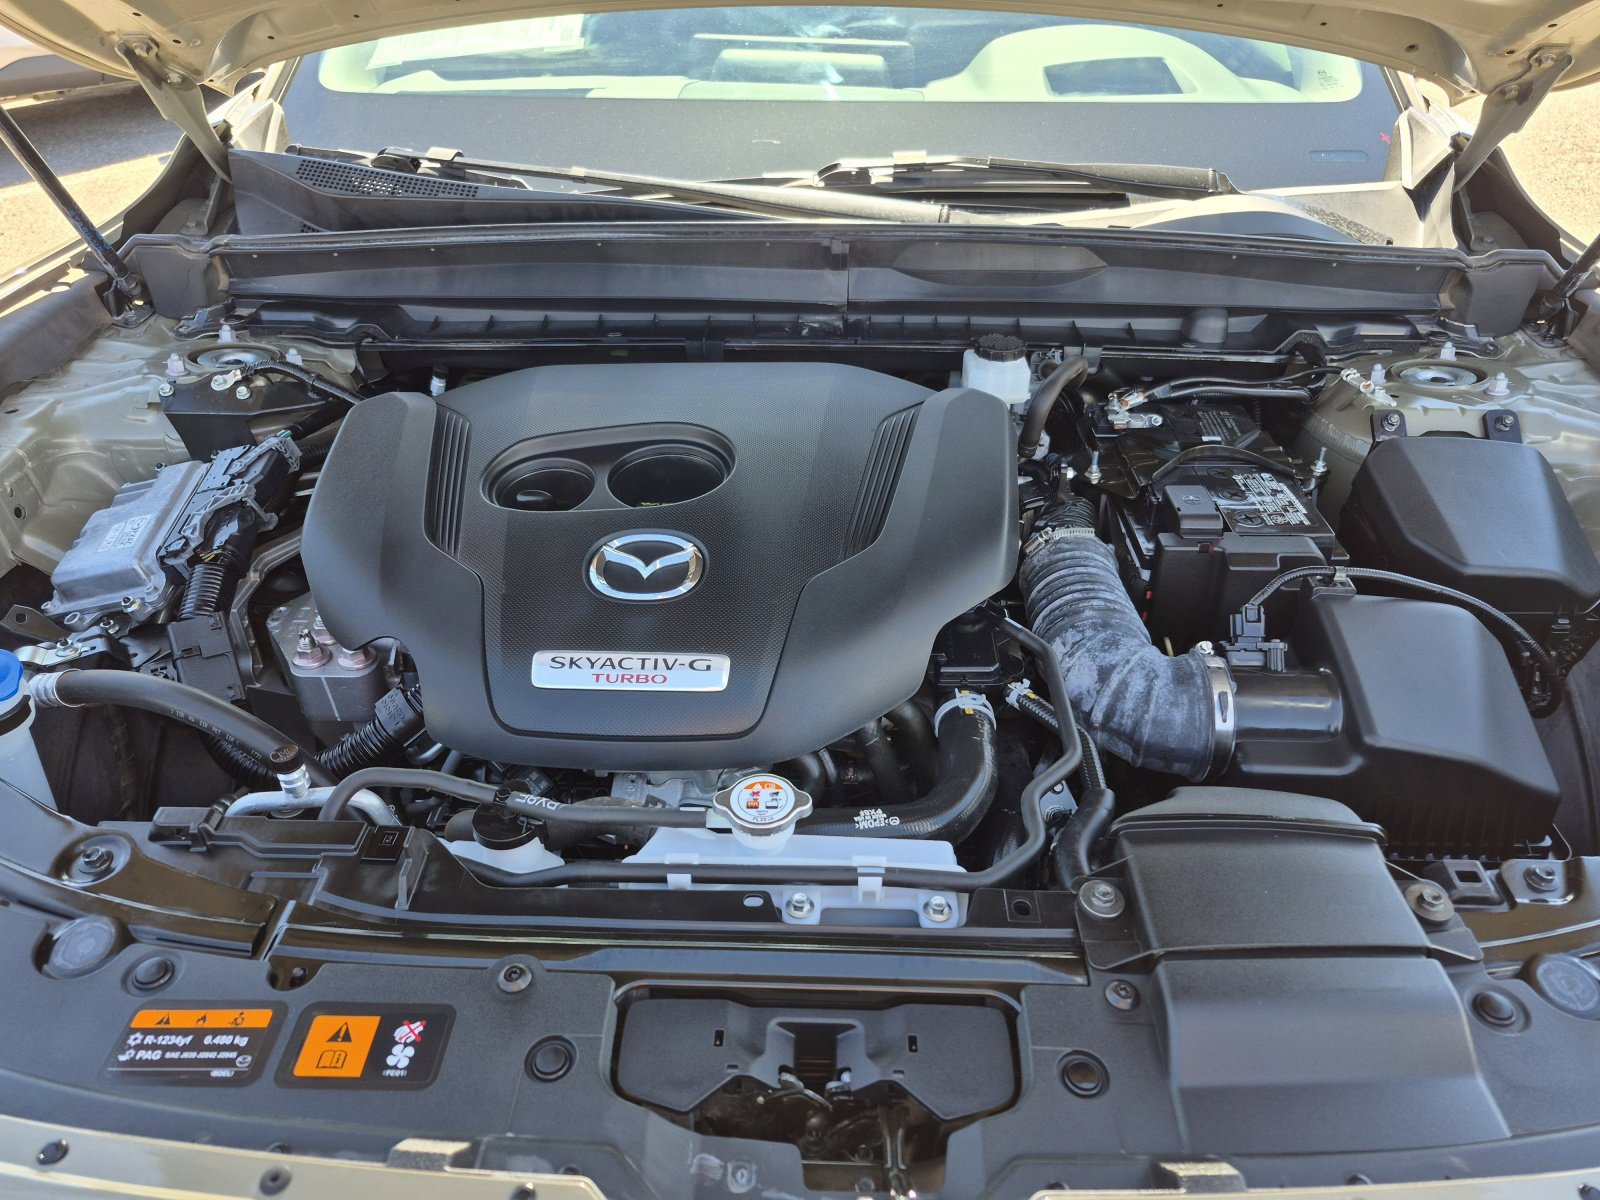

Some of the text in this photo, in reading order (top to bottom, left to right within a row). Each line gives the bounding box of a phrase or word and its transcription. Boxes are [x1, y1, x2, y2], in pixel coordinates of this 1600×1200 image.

[549, 656, 712, 672] SKYACTIV-G
[591, 673, 668, 684] TURBO
[143, 1034, 194, 1047] R-1234yf
[234, 1034, 249, 1047] kg
[135, 1049, 162, 1060] PAG
